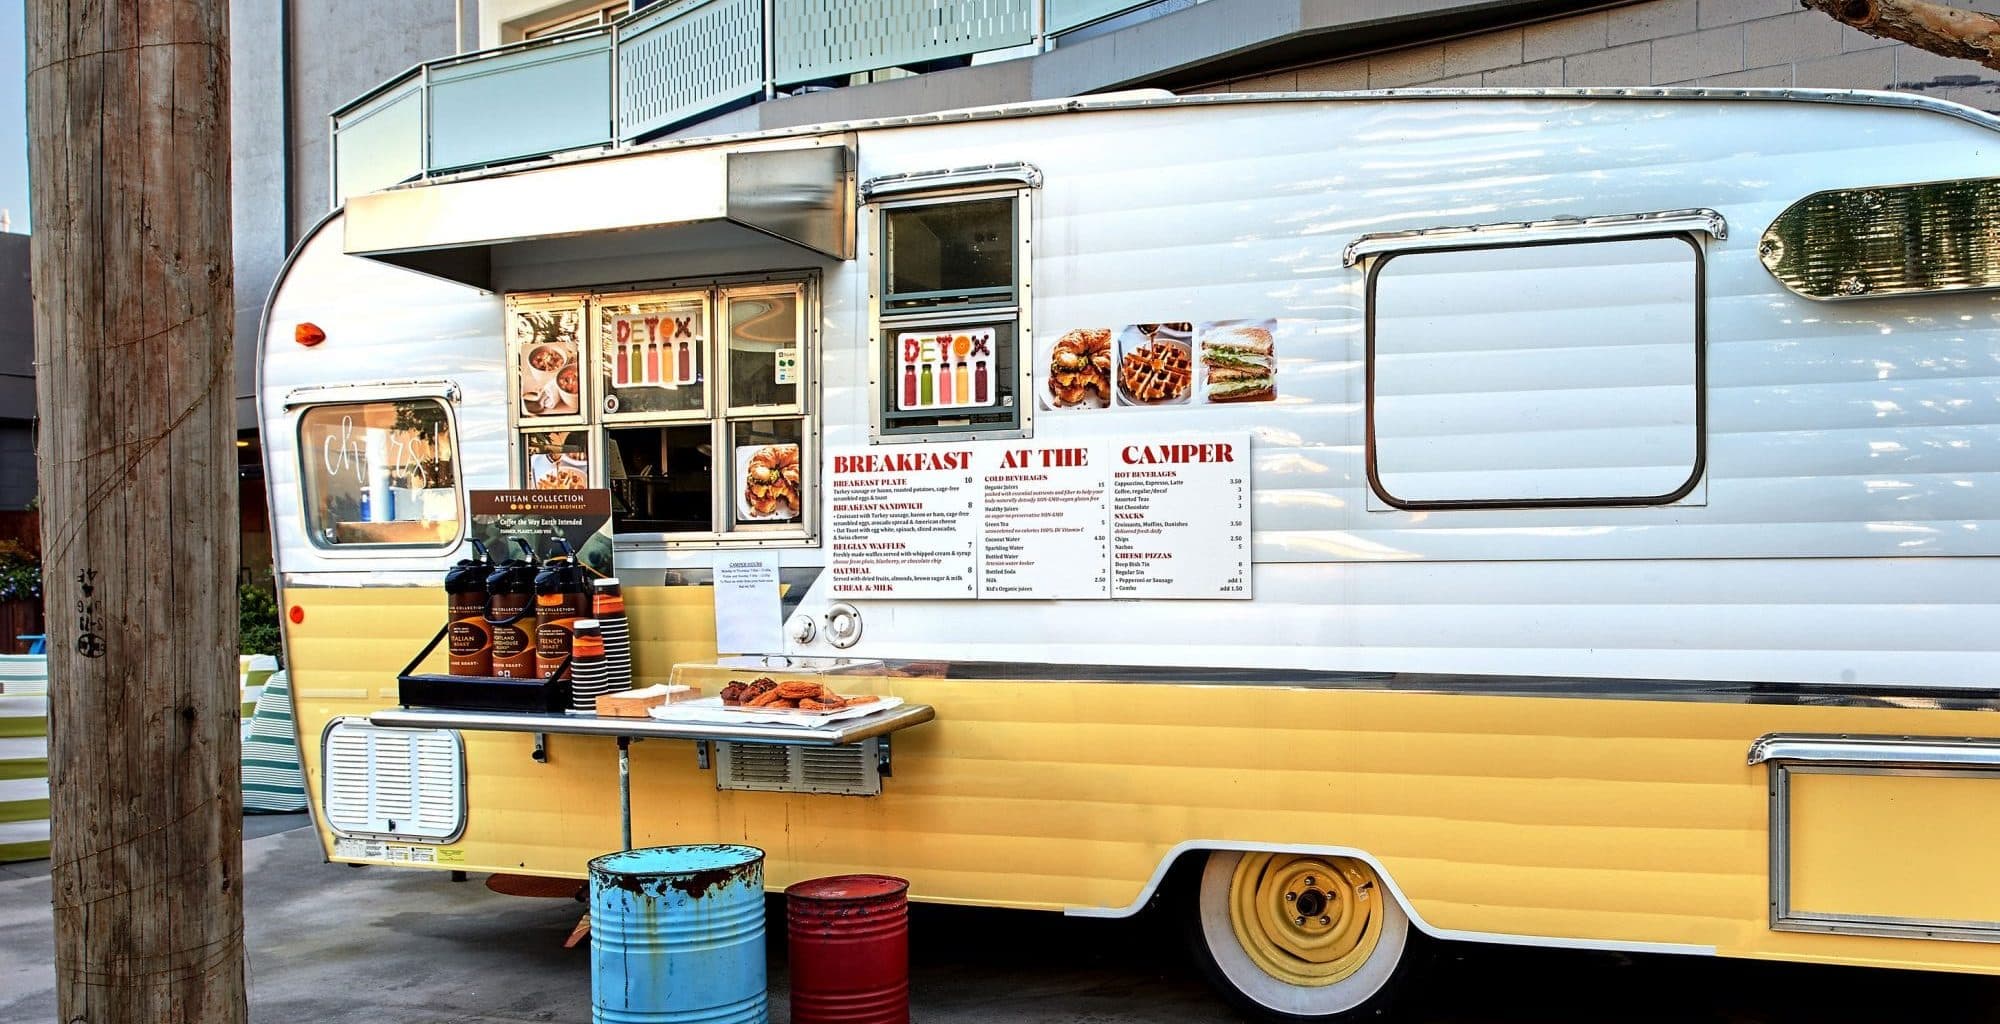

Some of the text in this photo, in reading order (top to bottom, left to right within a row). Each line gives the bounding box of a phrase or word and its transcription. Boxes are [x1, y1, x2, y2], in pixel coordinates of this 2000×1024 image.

[617, 316, 691, 343] DETOX
[904, 334, 990, 362] DETOX
[324, 415, 440, 490] chrs!
[834, 443, 1234, 473] BREAKFAST AT THE CAMPER
[833, 479, 879, 487] BREAKFAST
[881, 478, 907, 486] PLATE
[494, 494, 584, 503] ARTISAN COLLECTION
